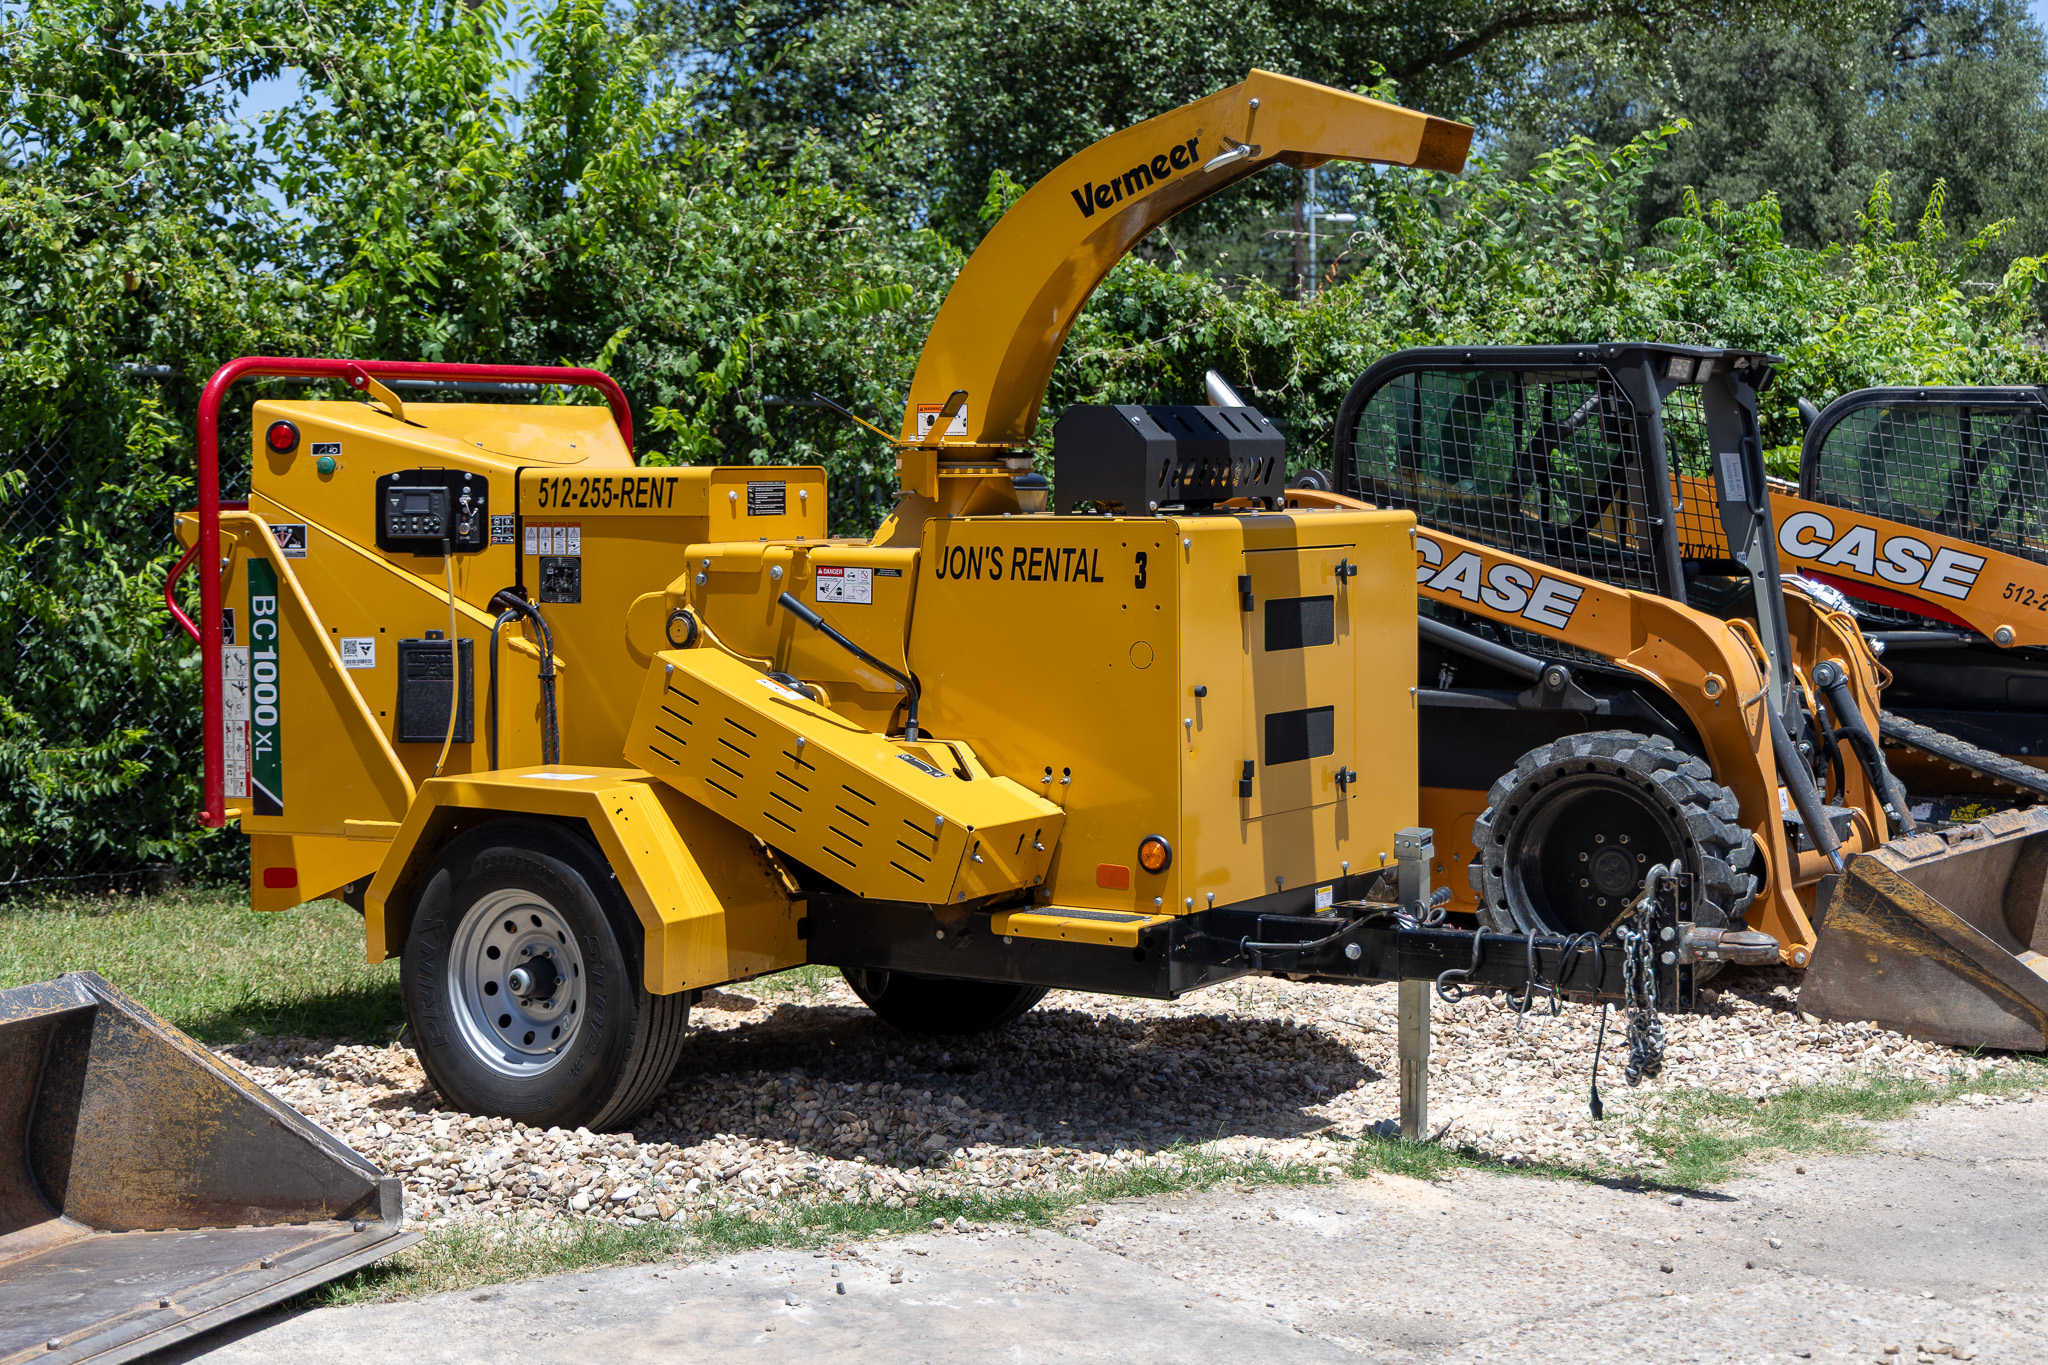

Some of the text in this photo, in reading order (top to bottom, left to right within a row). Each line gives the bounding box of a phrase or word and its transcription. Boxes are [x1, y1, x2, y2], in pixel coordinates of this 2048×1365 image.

[1071, 137, 1199, 218] Vermeer
[538, 477, 679, 508] 512-255-RENT
[823, 568, 843, 576] DANGER
[936, 545, 1104, 583] JON'S RENTAL
[1134, 551, 1148, 589] 3
[1778, 511, 1988, 601] CASE
[1417, 535, 1585, 631] CASE
